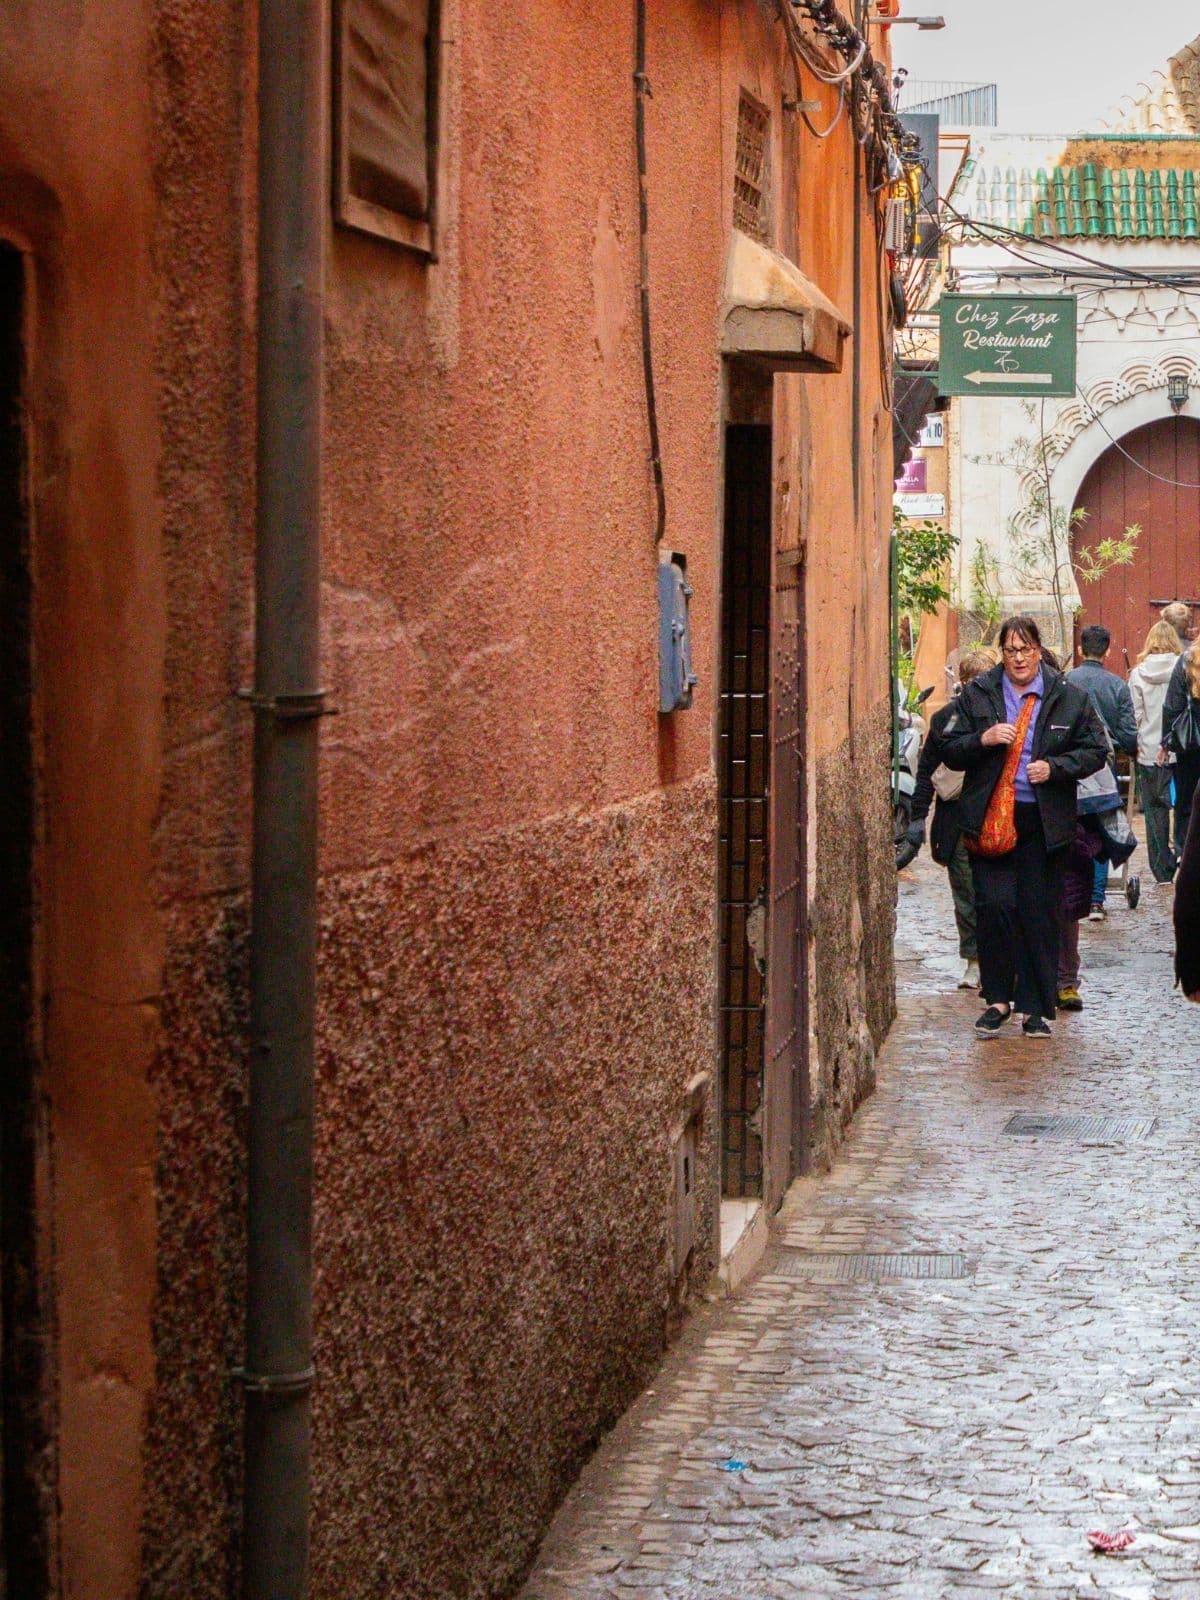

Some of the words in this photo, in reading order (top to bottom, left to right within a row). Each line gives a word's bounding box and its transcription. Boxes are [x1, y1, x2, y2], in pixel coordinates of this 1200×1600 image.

[955, 303, 999, 330] Chez
[1005, 305, 1060, 331] Zaza
[962, 329, 1053, 350] Restaurant
[934, 422, 943, 438] 10
